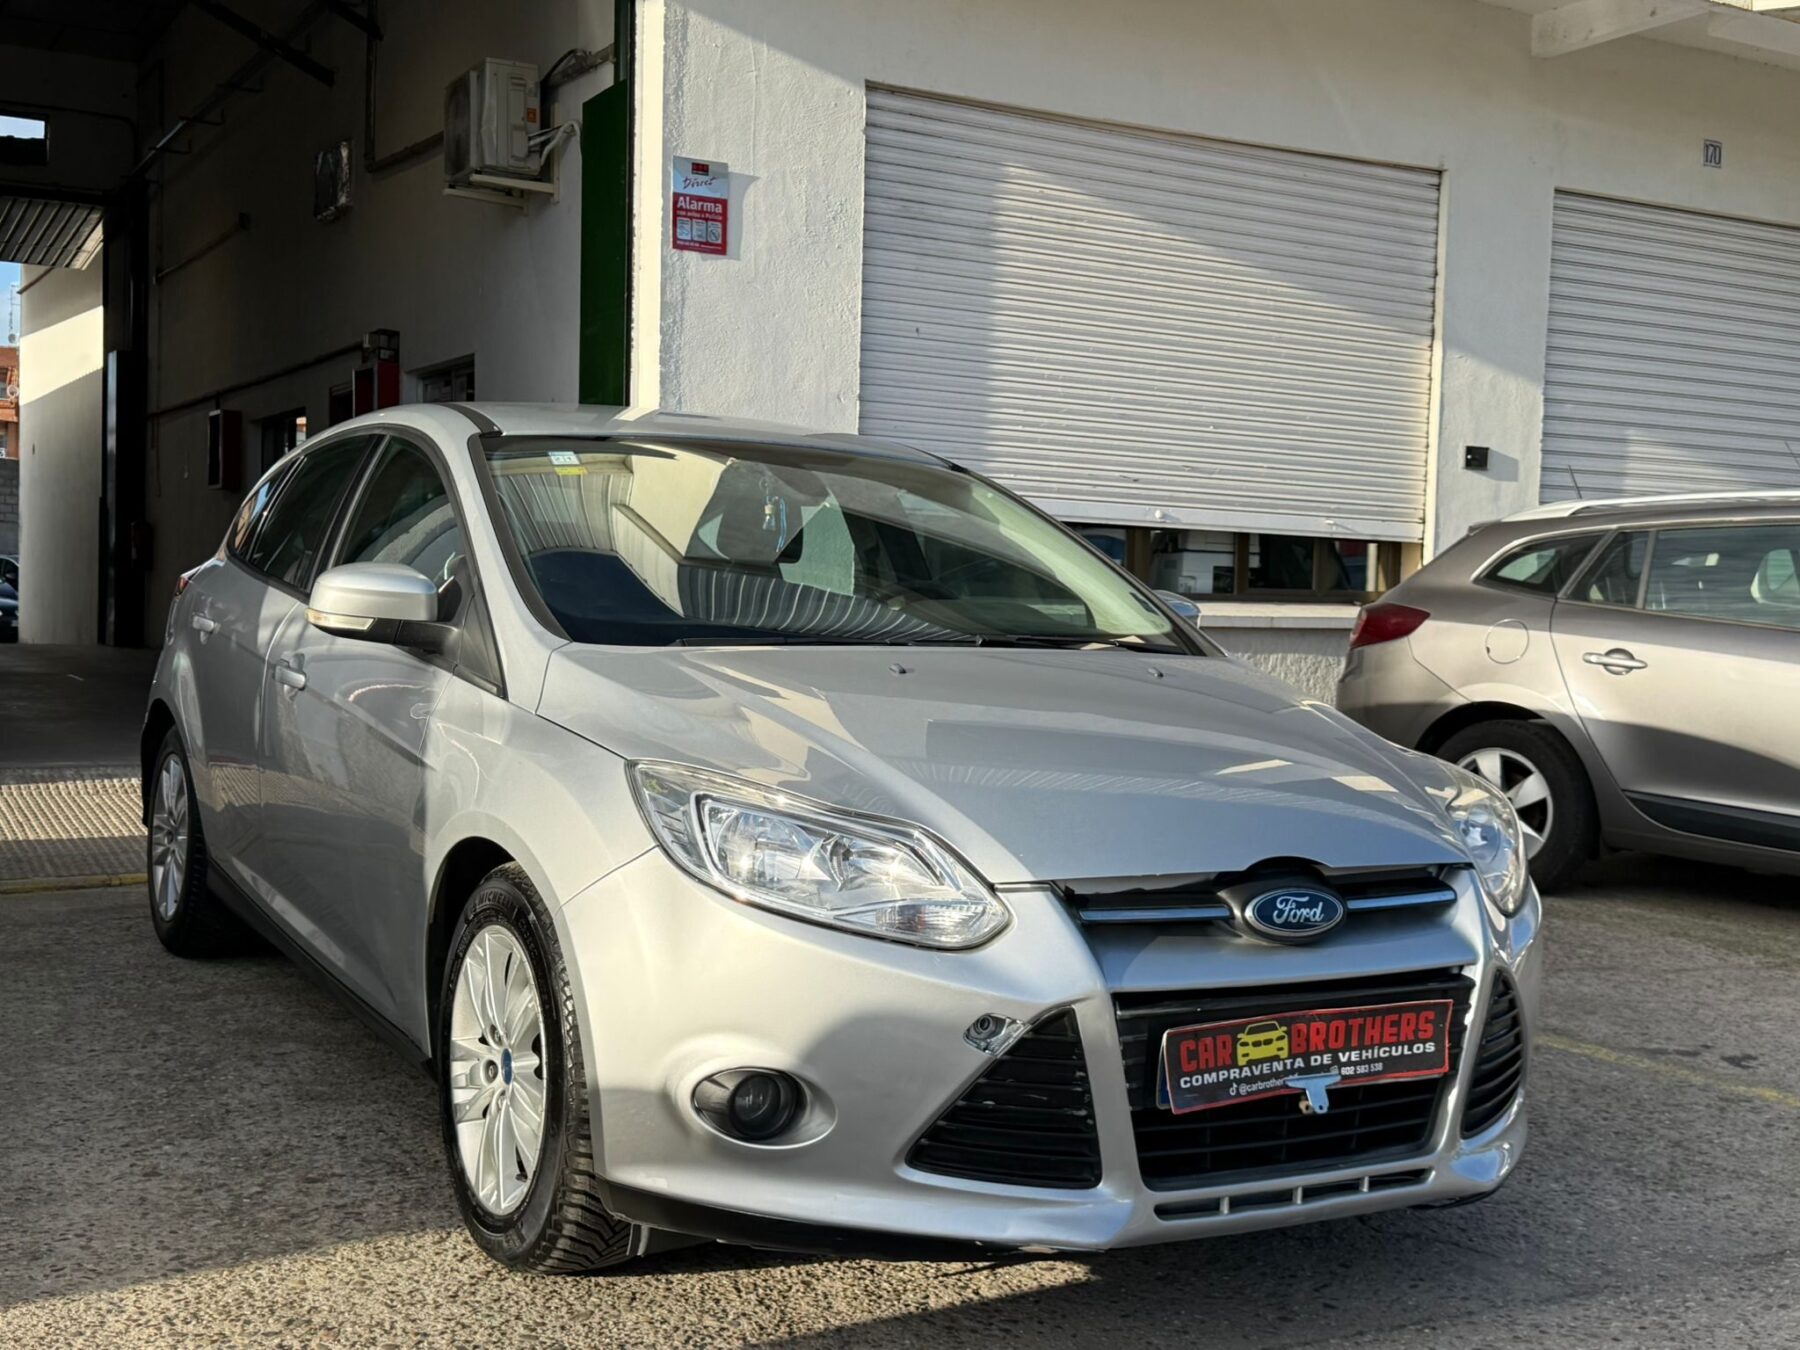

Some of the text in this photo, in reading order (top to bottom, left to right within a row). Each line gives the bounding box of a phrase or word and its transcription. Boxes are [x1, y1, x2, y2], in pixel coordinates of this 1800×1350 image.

[676, 196, 722, 213] Alarma
[1272, 895, 1325, 924] Ford
[1179, 1011, 1436, 1072] CAR BROTHERS
[1310, 1054, 1333, 1066] DE
[1338, 1042, 1436, 1063] VEHÍCULOS
